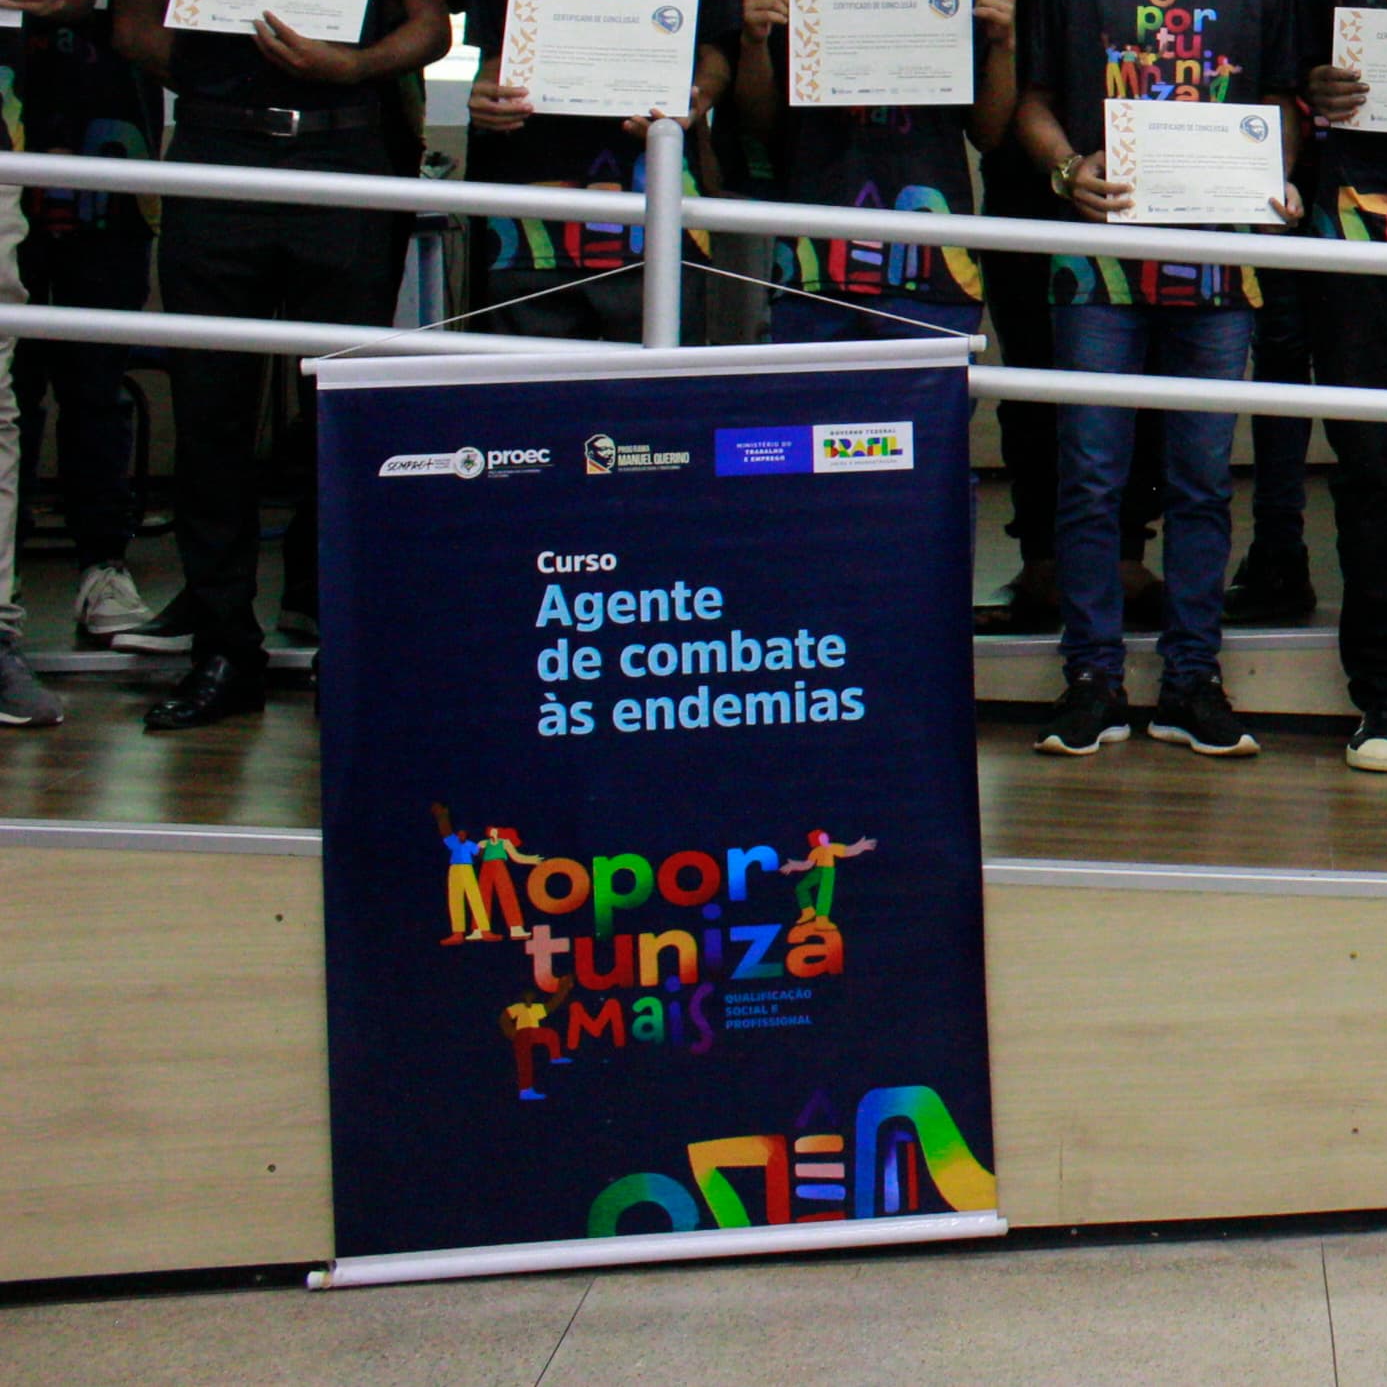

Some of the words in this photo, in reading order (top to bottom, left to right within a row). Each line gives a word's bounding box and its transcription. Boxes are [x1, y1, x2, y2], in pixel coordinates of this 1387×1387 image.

[1137, 6, 1217, 44] por
[1156, 27, 1202, 59] tu
[1175, 50, 1215, 85] ni
[488, 449, 550, 470] proec
[618, 453, 653, 466] MANUEL
[823, 436, 903, 458] BRASIL
[537, 551, 617, 574] Curso
[535, 581, 724, 632] Agente
[537, 638, 602, 682] de
[620, 629, 846, 678] combate
[537, 692, 595, 737] às
[612, 680, 865, 732] endemias
[525, 903, 844, 994] tuniza
[725, 989, 812, 1005] QUALIFICAÇÃO
[725, 1004, 768, 1017] SOCIAL
[771, 1004, 778, 1015] E
[725, 1015, 813, 1030] PROFISSIONAL
